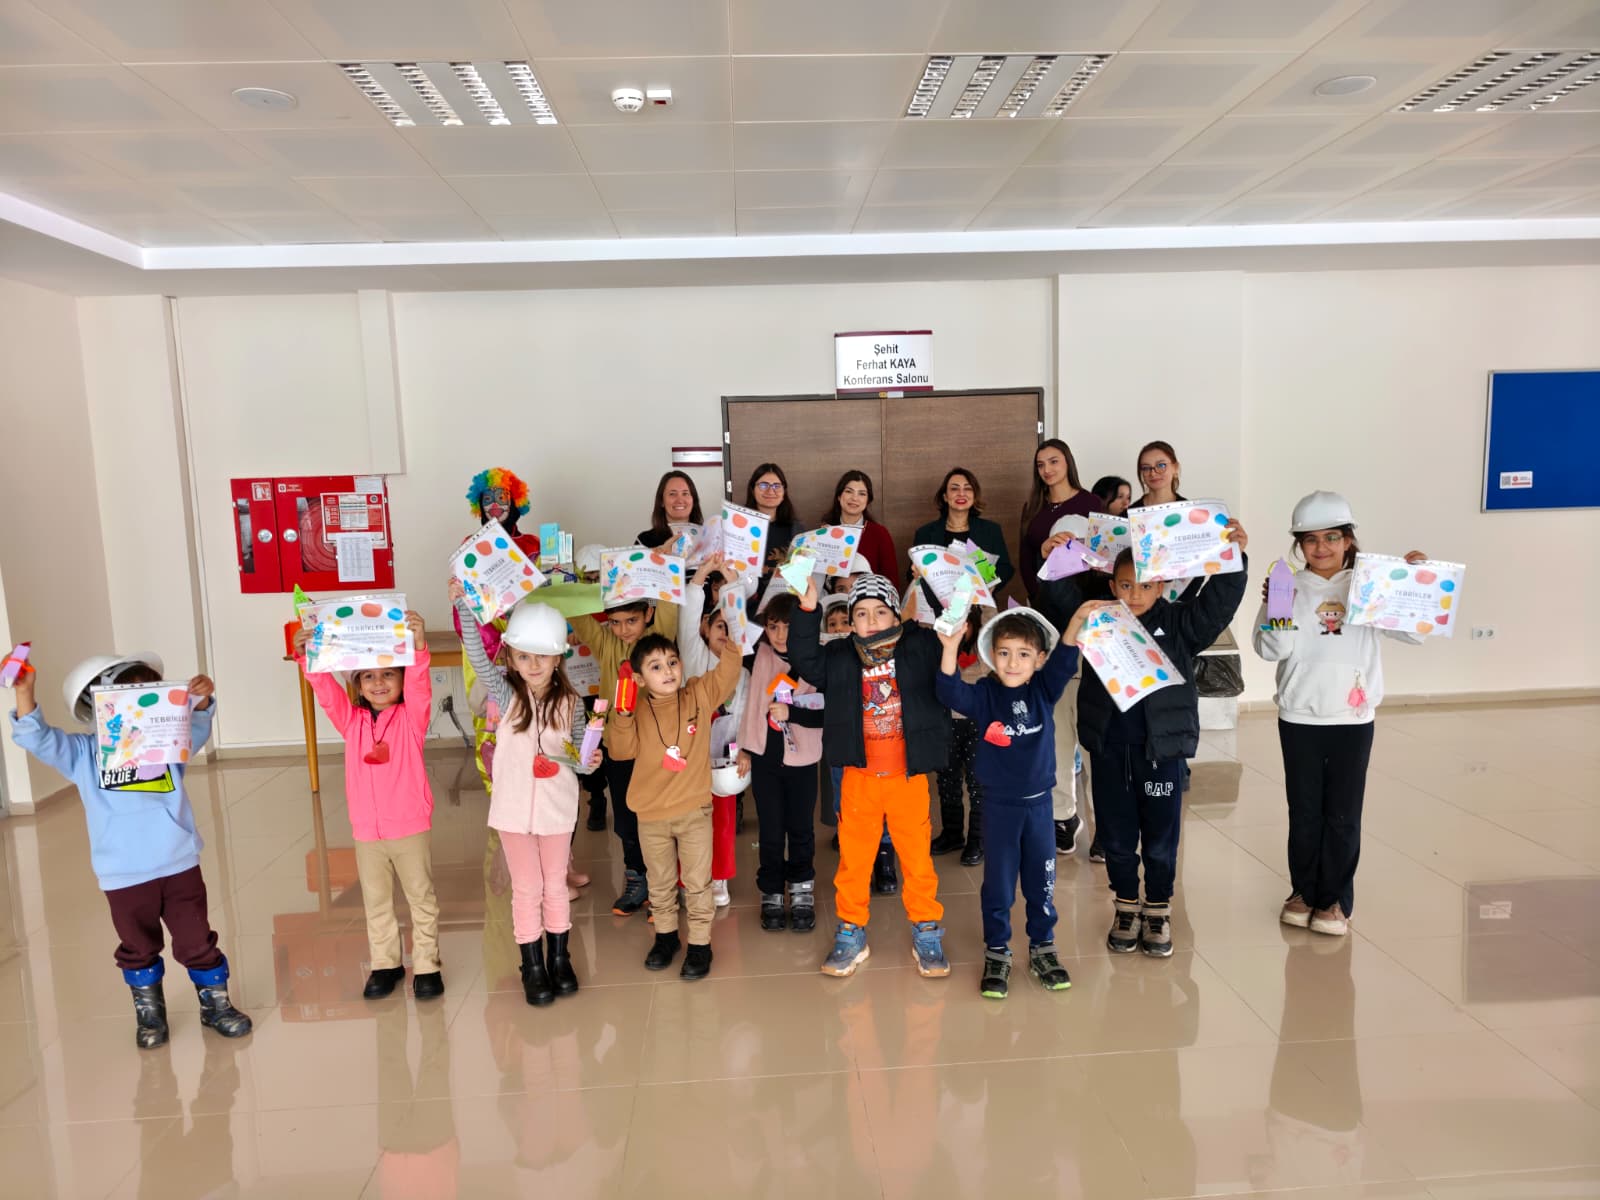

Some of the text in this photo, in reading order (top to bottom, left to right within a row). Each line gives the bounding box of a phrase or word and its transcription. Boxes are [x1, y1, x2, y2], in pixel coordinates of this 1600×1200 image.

[873, 343, 899, 357] Şehit
[856, 358, 917, 371] Ferhat KAYA
[843, 373, 929, 386] Konferans Salonu
[104, 770, 131, 786] BLUE
[1144, 781, 1174, 797] GAP
